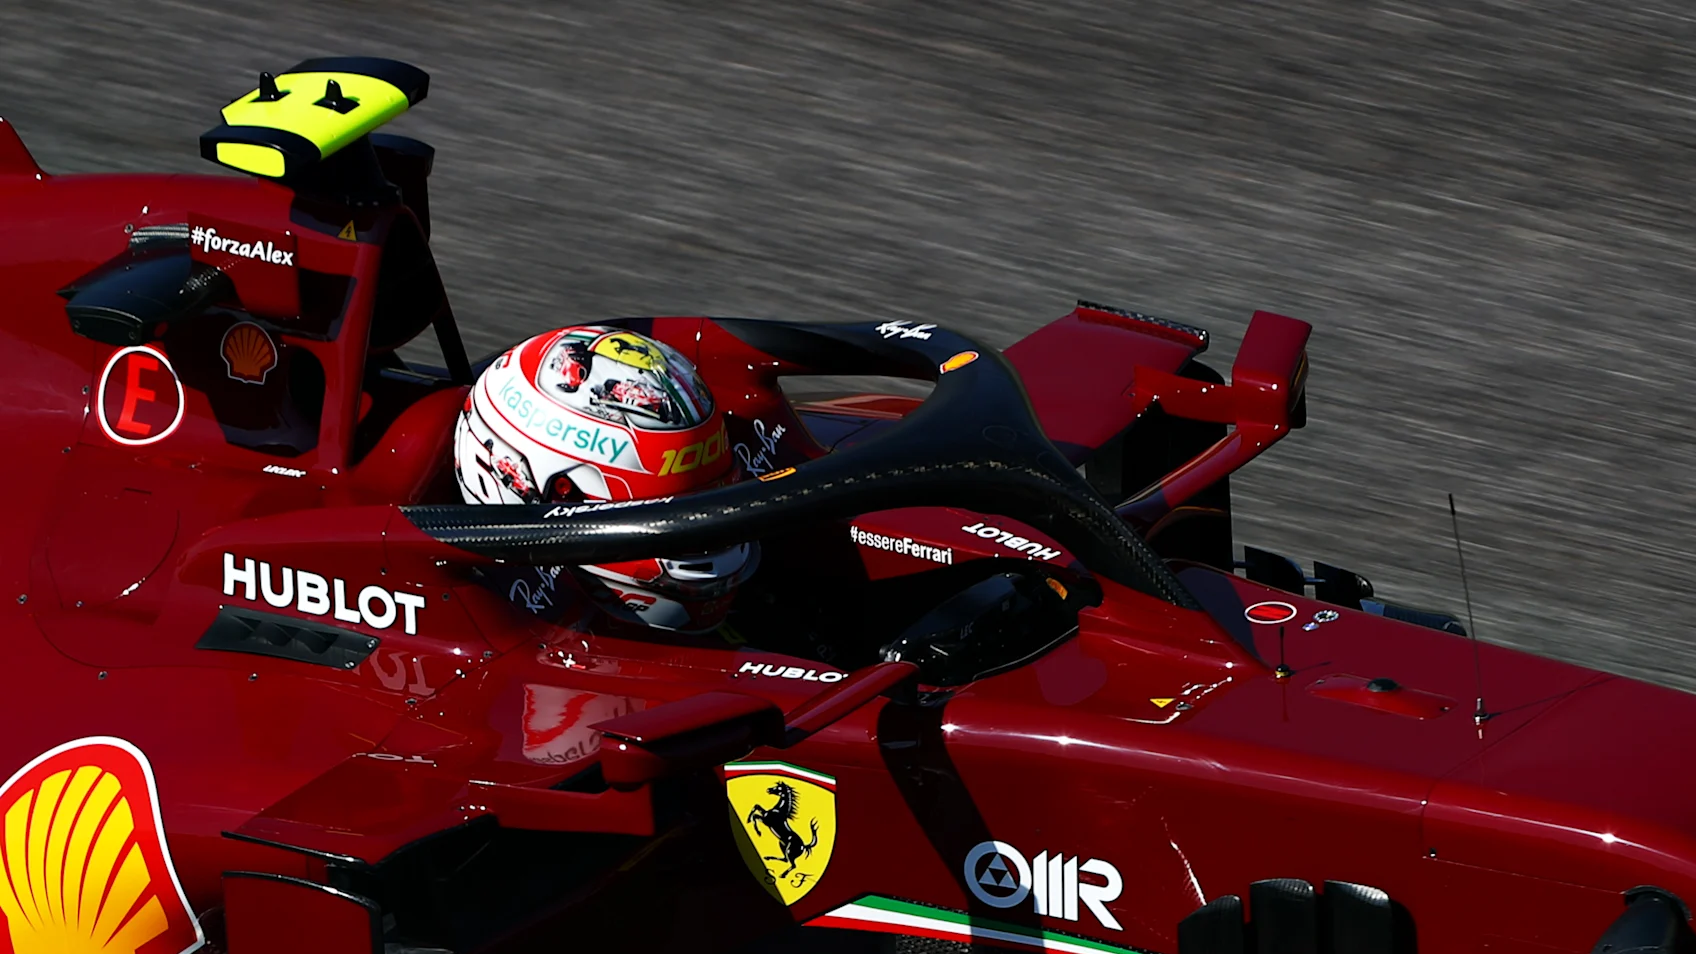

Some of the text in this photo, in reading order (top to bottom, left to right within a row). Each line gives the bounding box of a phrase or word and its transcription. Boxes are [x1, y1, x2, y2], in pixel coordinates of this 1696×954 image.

[191, 225, 294, 267] #forzaAlex
[116, 353, 159, 435] E
[498, 376, 629, 464] kaspersky
[850, 525, 953, 565] #essereFerrari
[961, 522, 1062, 561] HUBLOT
[223, 552, 426, 636] HUBLOT
[739, 661, 849, 683] HUBLO
